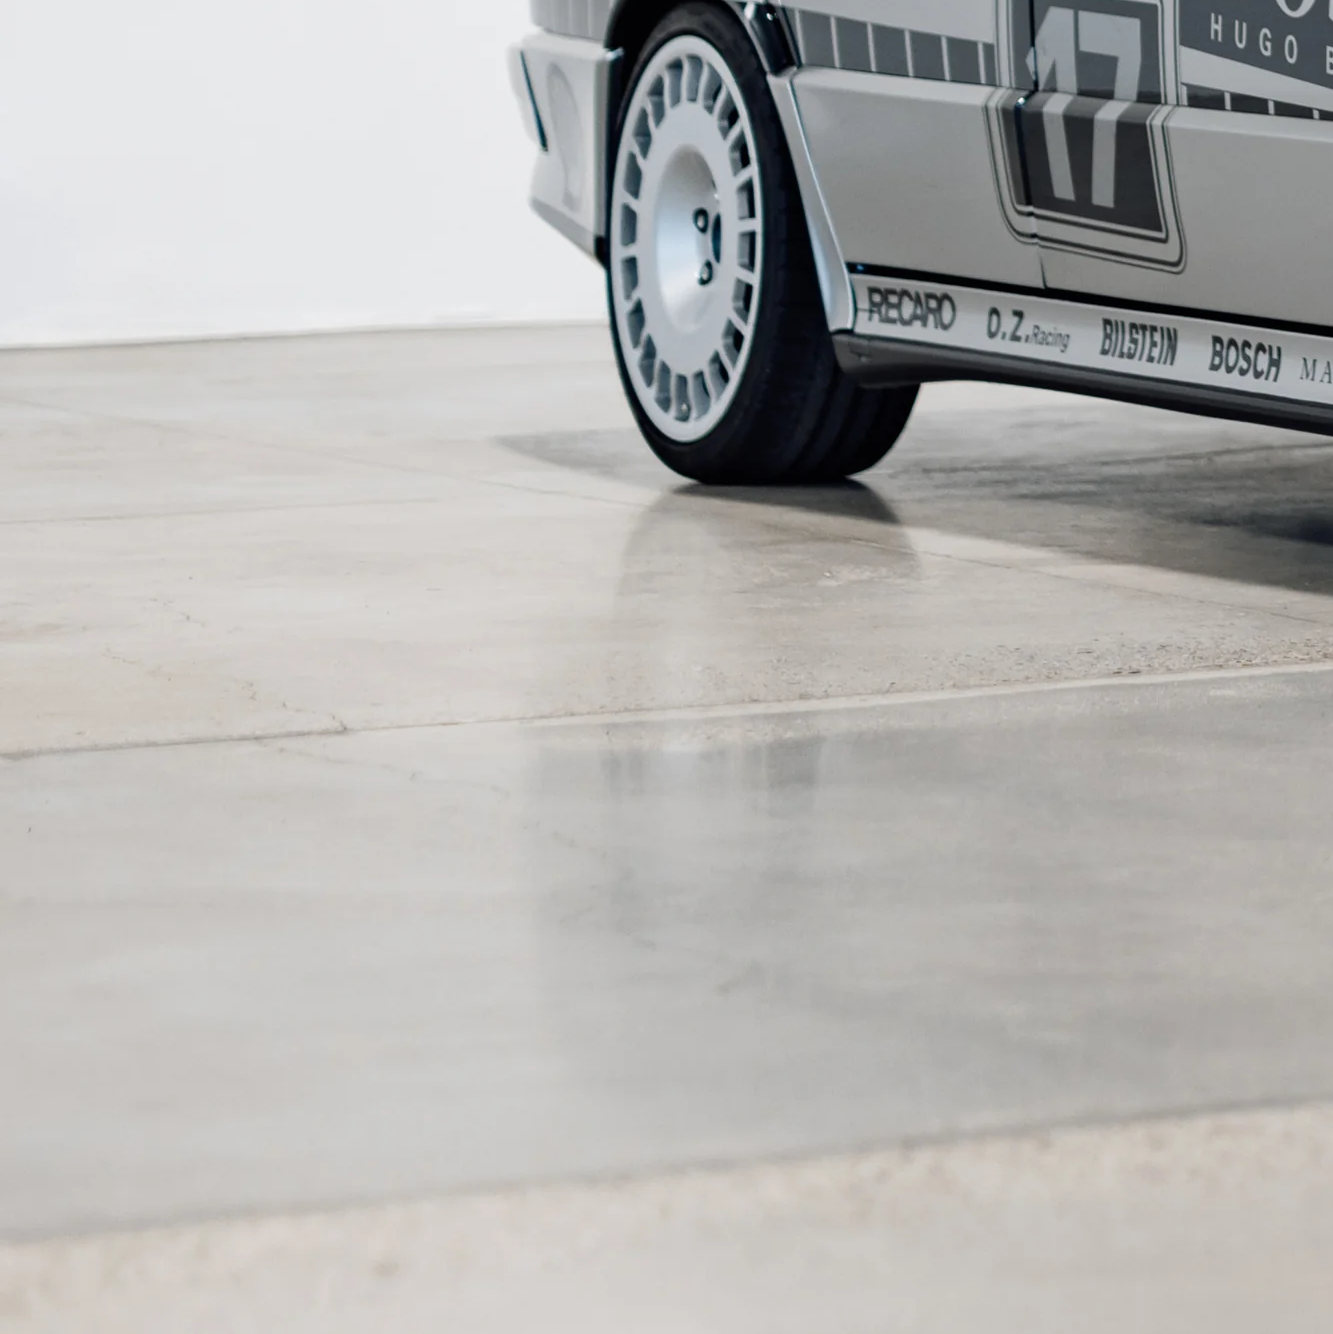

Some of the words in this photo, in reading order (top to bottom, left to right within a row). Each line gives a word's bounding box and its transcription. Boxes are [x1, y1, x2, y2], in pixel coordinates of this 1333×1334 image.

[1210, 12, 1298, 64] HUGO
[1024, 5, 1142, 208] 17
[866, 286, 957, 331] RECARO
[1098, 317, 1179, 366] BILSTEIN
[1208, 334, 1283, 382] BOSCH
